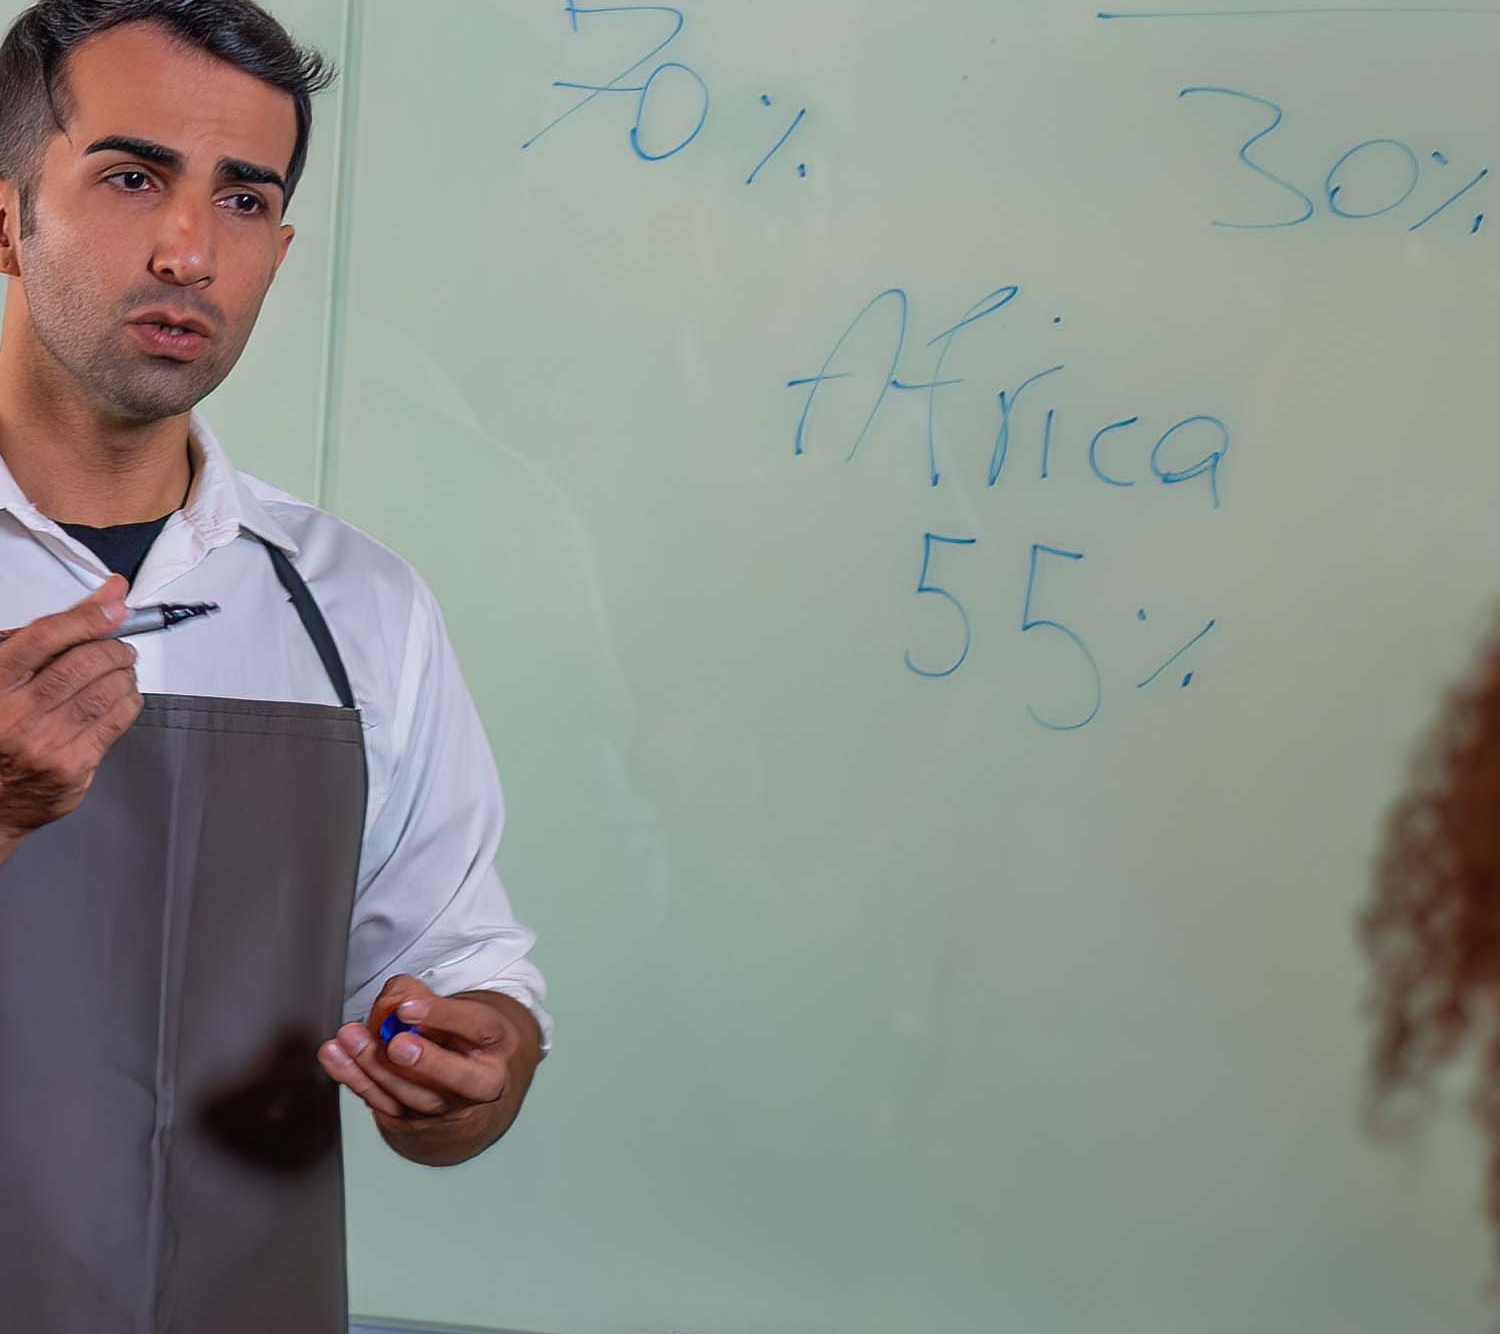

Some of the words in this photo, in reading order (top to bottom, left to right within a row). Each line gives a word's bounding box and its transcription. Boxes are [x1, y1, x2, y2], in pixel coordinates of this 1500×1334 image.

[1177, 85, 1491, 235] 30%
[785, 284, 1231, 510] Africa
[903, 531, 1218, 733] 55%
